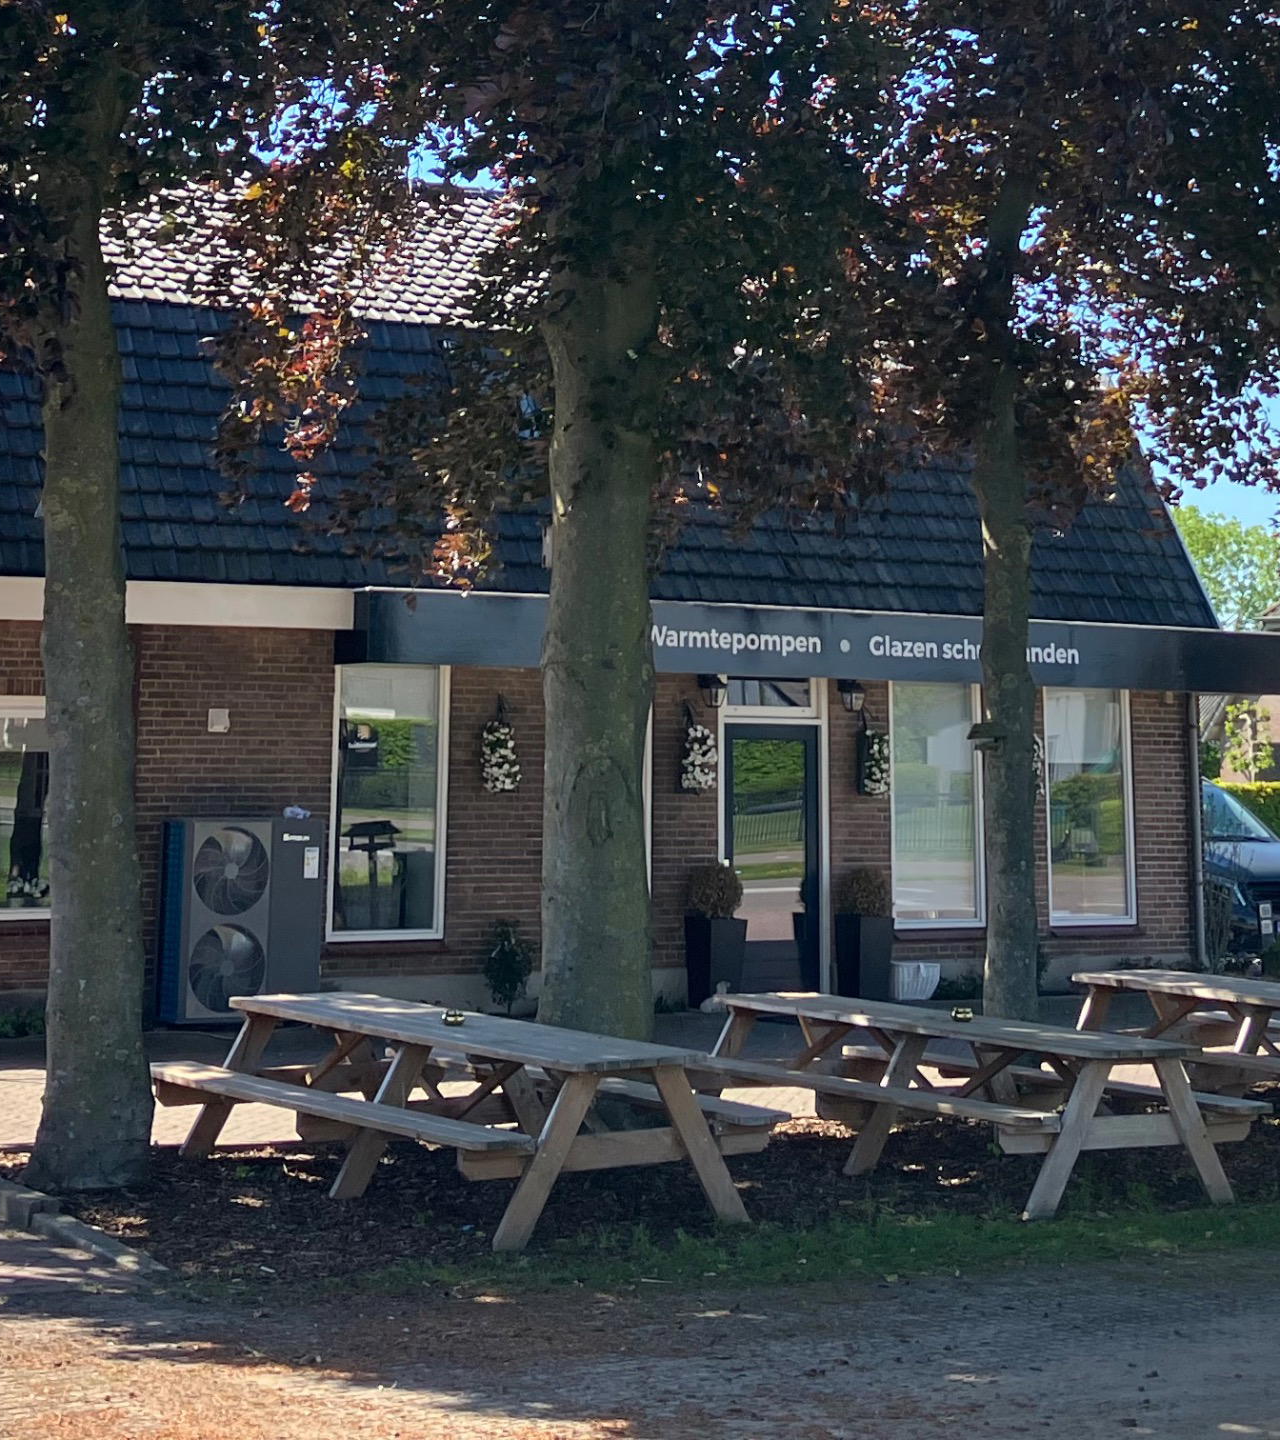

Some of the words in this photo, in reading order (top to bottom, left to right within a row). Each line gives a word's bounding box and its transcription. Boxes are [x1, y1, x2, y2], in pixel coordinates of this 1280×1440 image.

[651, 624, 822, 656] Warmtepompen
[869, 635, 938, 659] Glazen
[942, 638, 1080, 665] schnden
